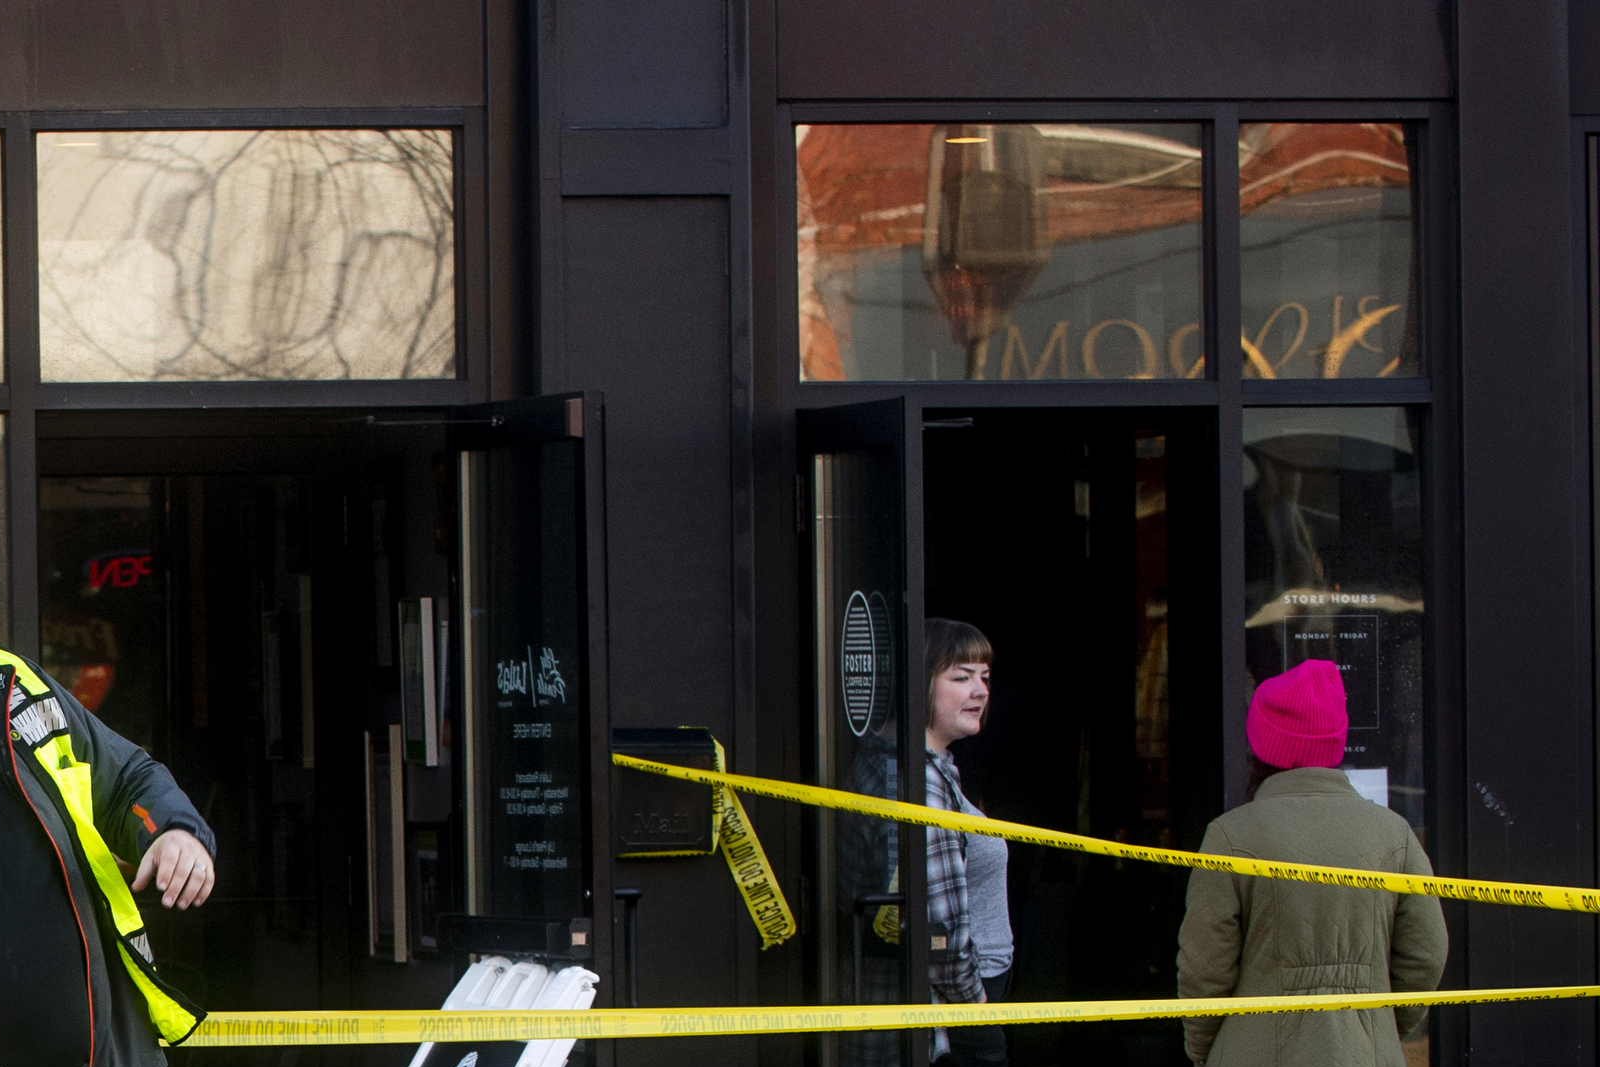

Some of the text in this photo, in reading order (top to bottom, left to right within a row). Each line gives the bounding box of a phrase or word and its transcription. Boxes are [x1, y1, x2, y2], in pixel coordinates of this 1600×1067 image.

[1284, 594, 1378, 605] STORE HOURS
[1294, 632, 1368, 640] MONDAY FRIDAY
[845, 654, 872, 673] FOSTER
[849, 677, 863, 687] COFFEE
[728, 841, 757, 867] NOT
[738, 862, 764, 883] DO
[745, 878, 775, 906] LINE
